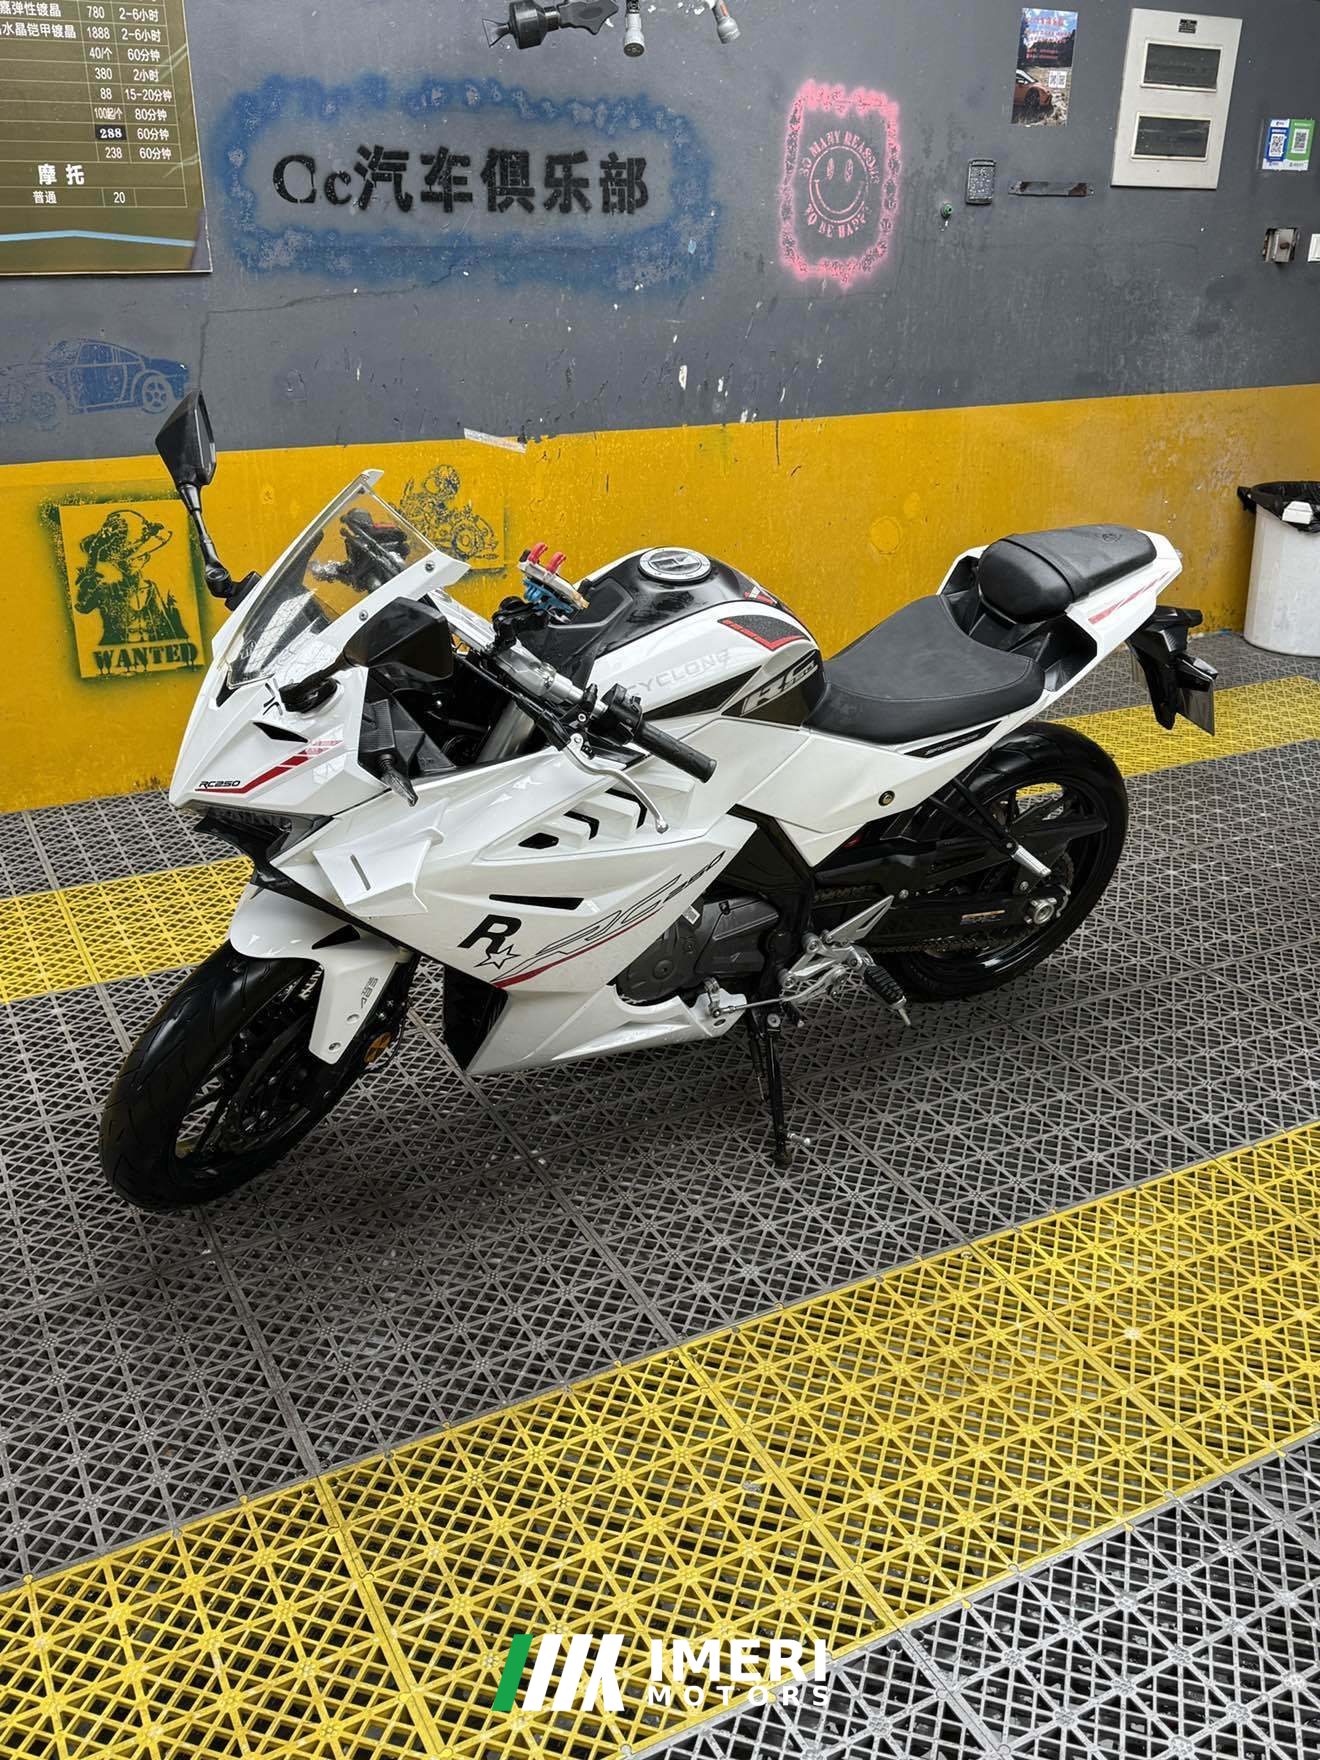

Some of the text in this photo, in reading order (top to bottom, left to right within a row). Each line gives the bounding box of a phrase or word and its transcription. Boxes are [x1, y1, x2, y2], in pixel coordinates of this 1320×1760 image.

[87, 6, 105, 19] 780
[119, 8, 159, 22] 2-6小时
[0, 21, 161, 43] 水晶铠甲镀晶 1888 2-6小时
[127, 48, 160, 62] 60分钟
[95, 67, 159, 82] 380 2小时
[100, 87, 172, 102] 88 15-20分钟
[135, 108, 167, 121] 80分钟
[99, 128, 169, 140] 288 60分钟
[809, 130, 841, 157] MANY
[105, 147, 171, 160] 238 60分钟
[38, 163, 85, 186] 摩托
[32, 190, 126, 205] 普通 20
[93, 642, 198, 674] WANTED
[199, 780, 241, 789] RC250
